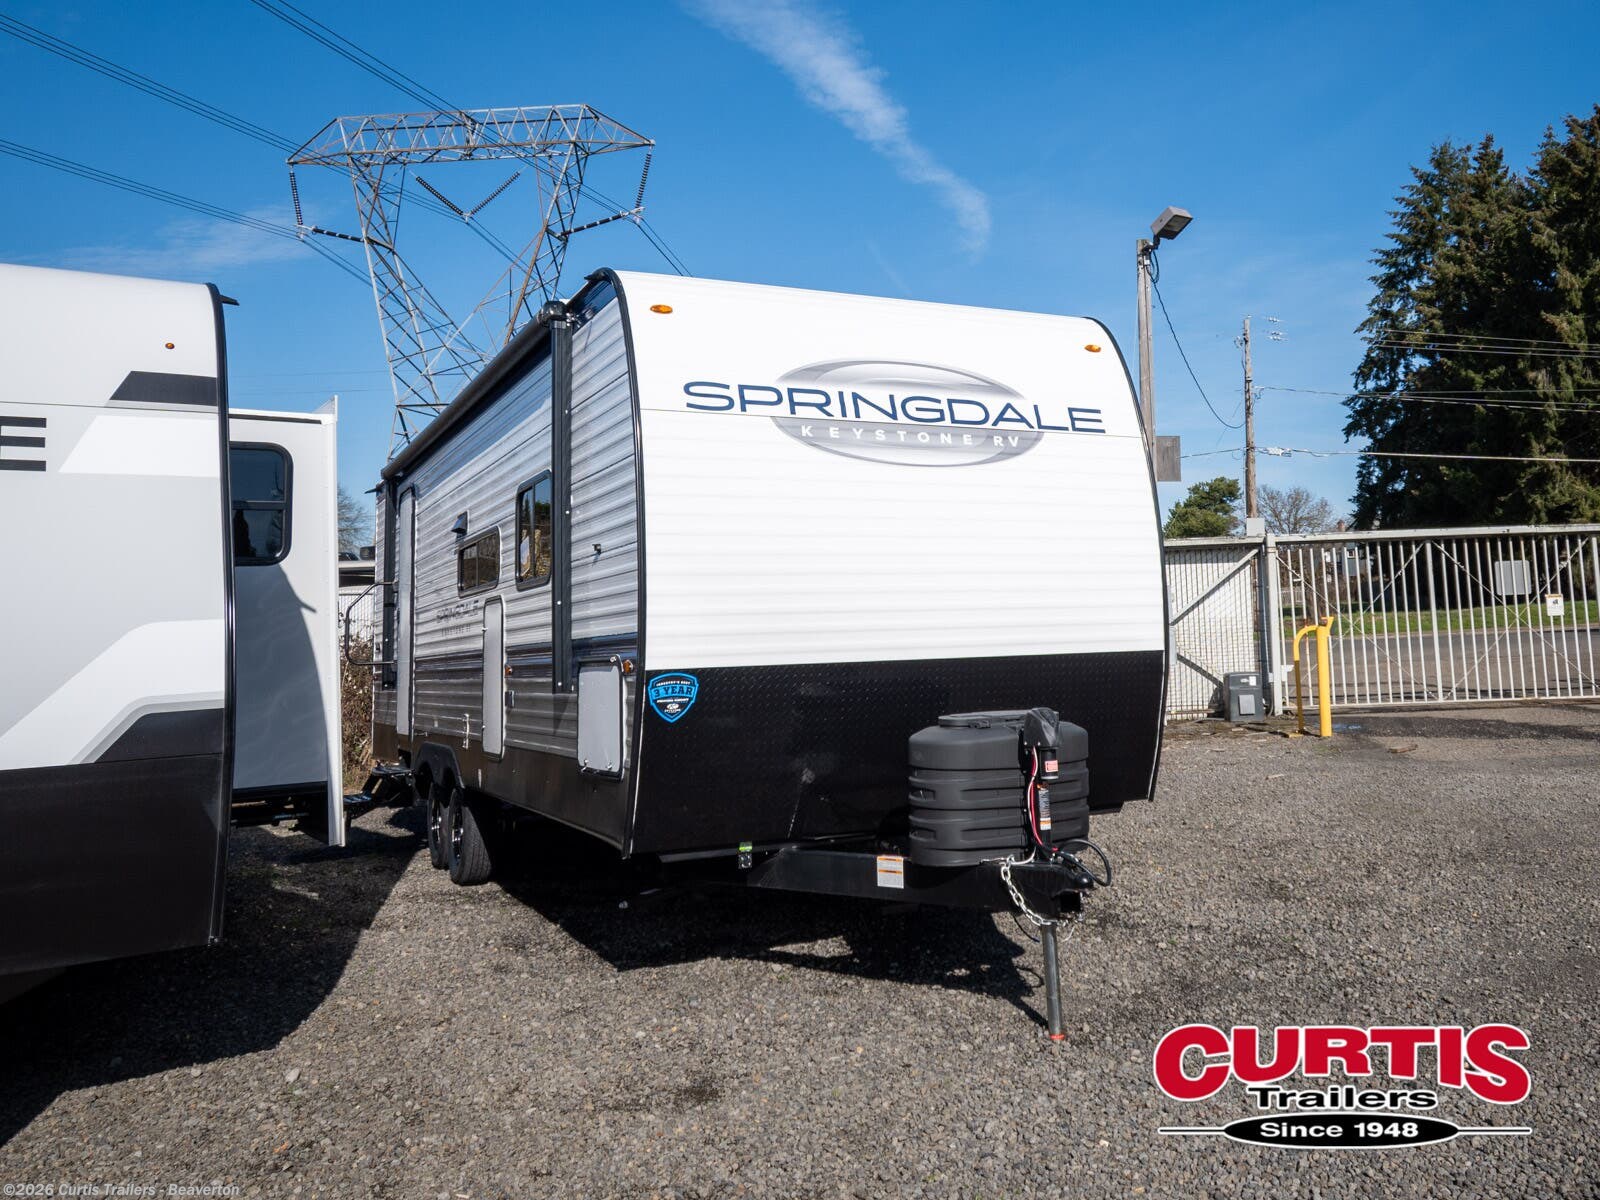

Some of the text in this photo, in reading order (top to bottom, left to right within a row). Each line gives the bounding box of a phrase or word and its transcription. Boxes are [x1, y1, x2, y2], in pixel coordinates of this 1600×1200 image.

[683, 381, 1106, 434] SPRINGDALE
[801, 424, 1020, 448] KEYSTONE RV
[653, 685, 693, 697] 3 YEAR
